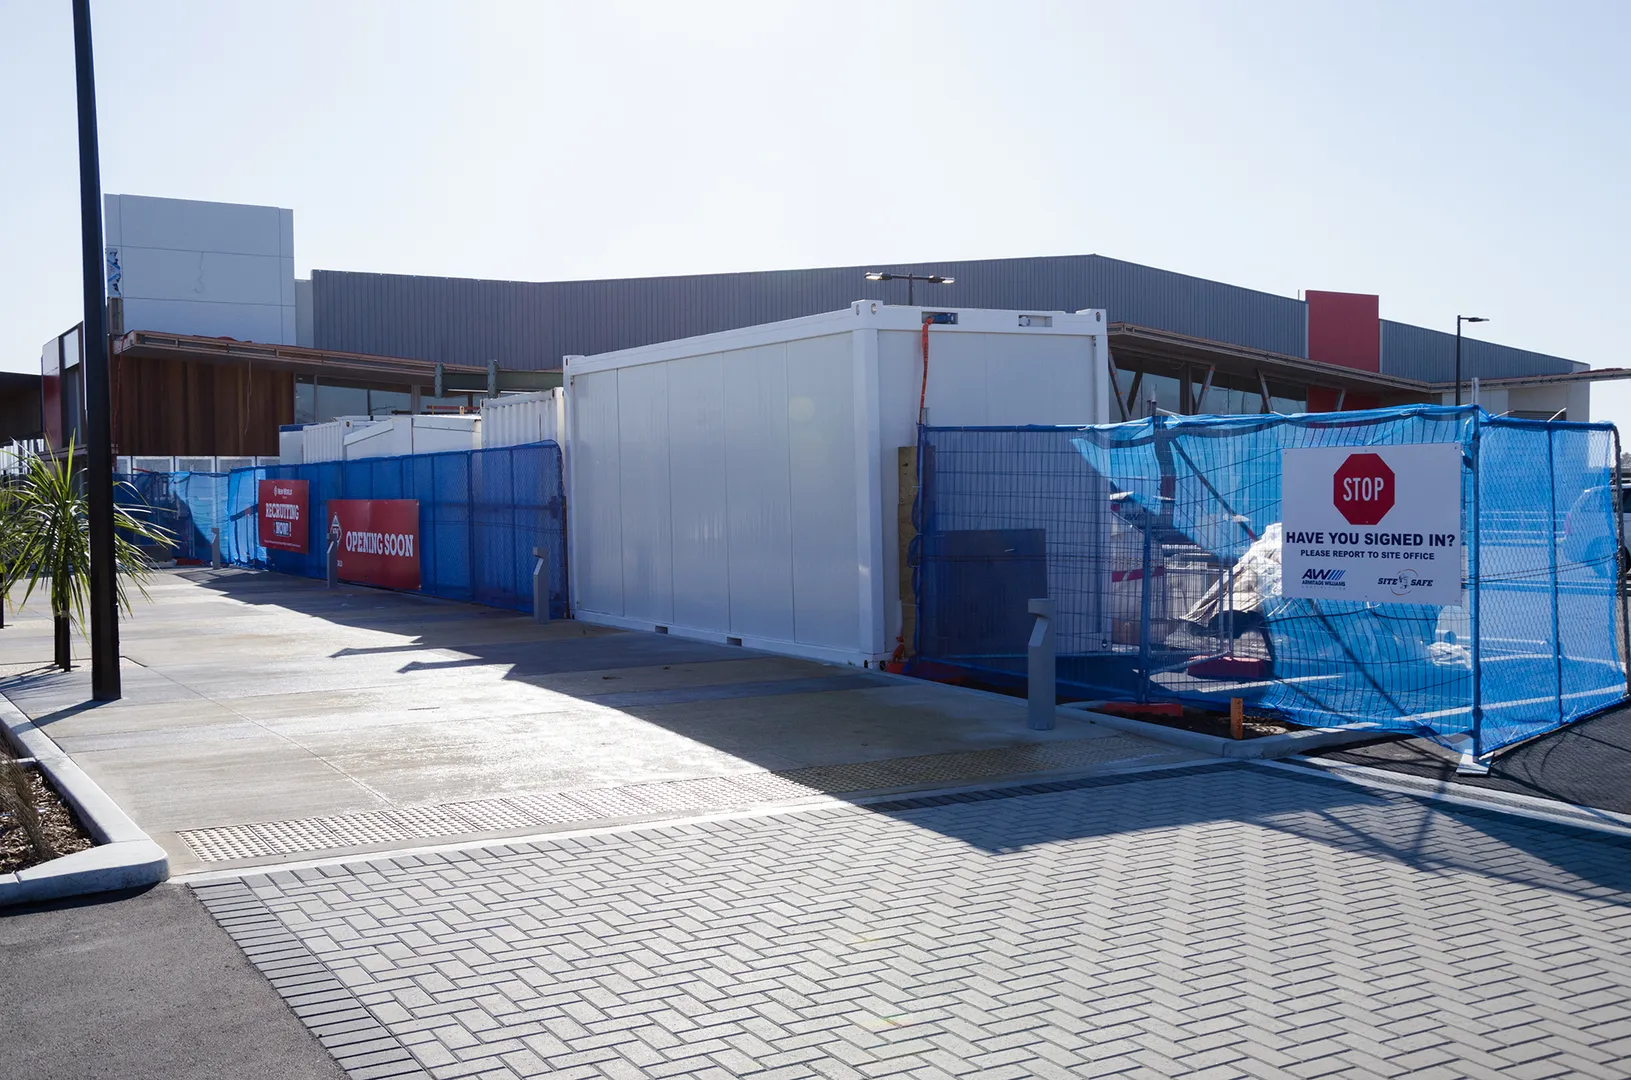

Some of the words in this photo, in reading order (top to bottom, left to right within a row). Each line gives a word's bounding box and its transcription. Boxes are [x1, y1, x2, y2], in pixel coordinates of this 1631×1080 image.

[1343, 477, 1384, 501] STOP
[265, 502, 299, 520] RECRUITING
[345, 530, 383, 555] OPENING
[384, 533, 414, 557] SOON
[1286, 532, 1324, 544] HAVE
[1328, 532, 1359, 545] YOU
[1364, 533, 1424, 546] SIGNED
[1429, 534, 1456, 547] IN?
[1300, 550, 1331, 558] PLEASE
[1332, 550, 1365, 559] REPORT
[1367, 551, 1379, 559] TO
[1381, 551, 1401, 560] SITE
[1403, 552, 1435, 560] OFFICE
[1377, 577, 1398, 586] SITE
[1410, 579, 1434, 587] SAFE
